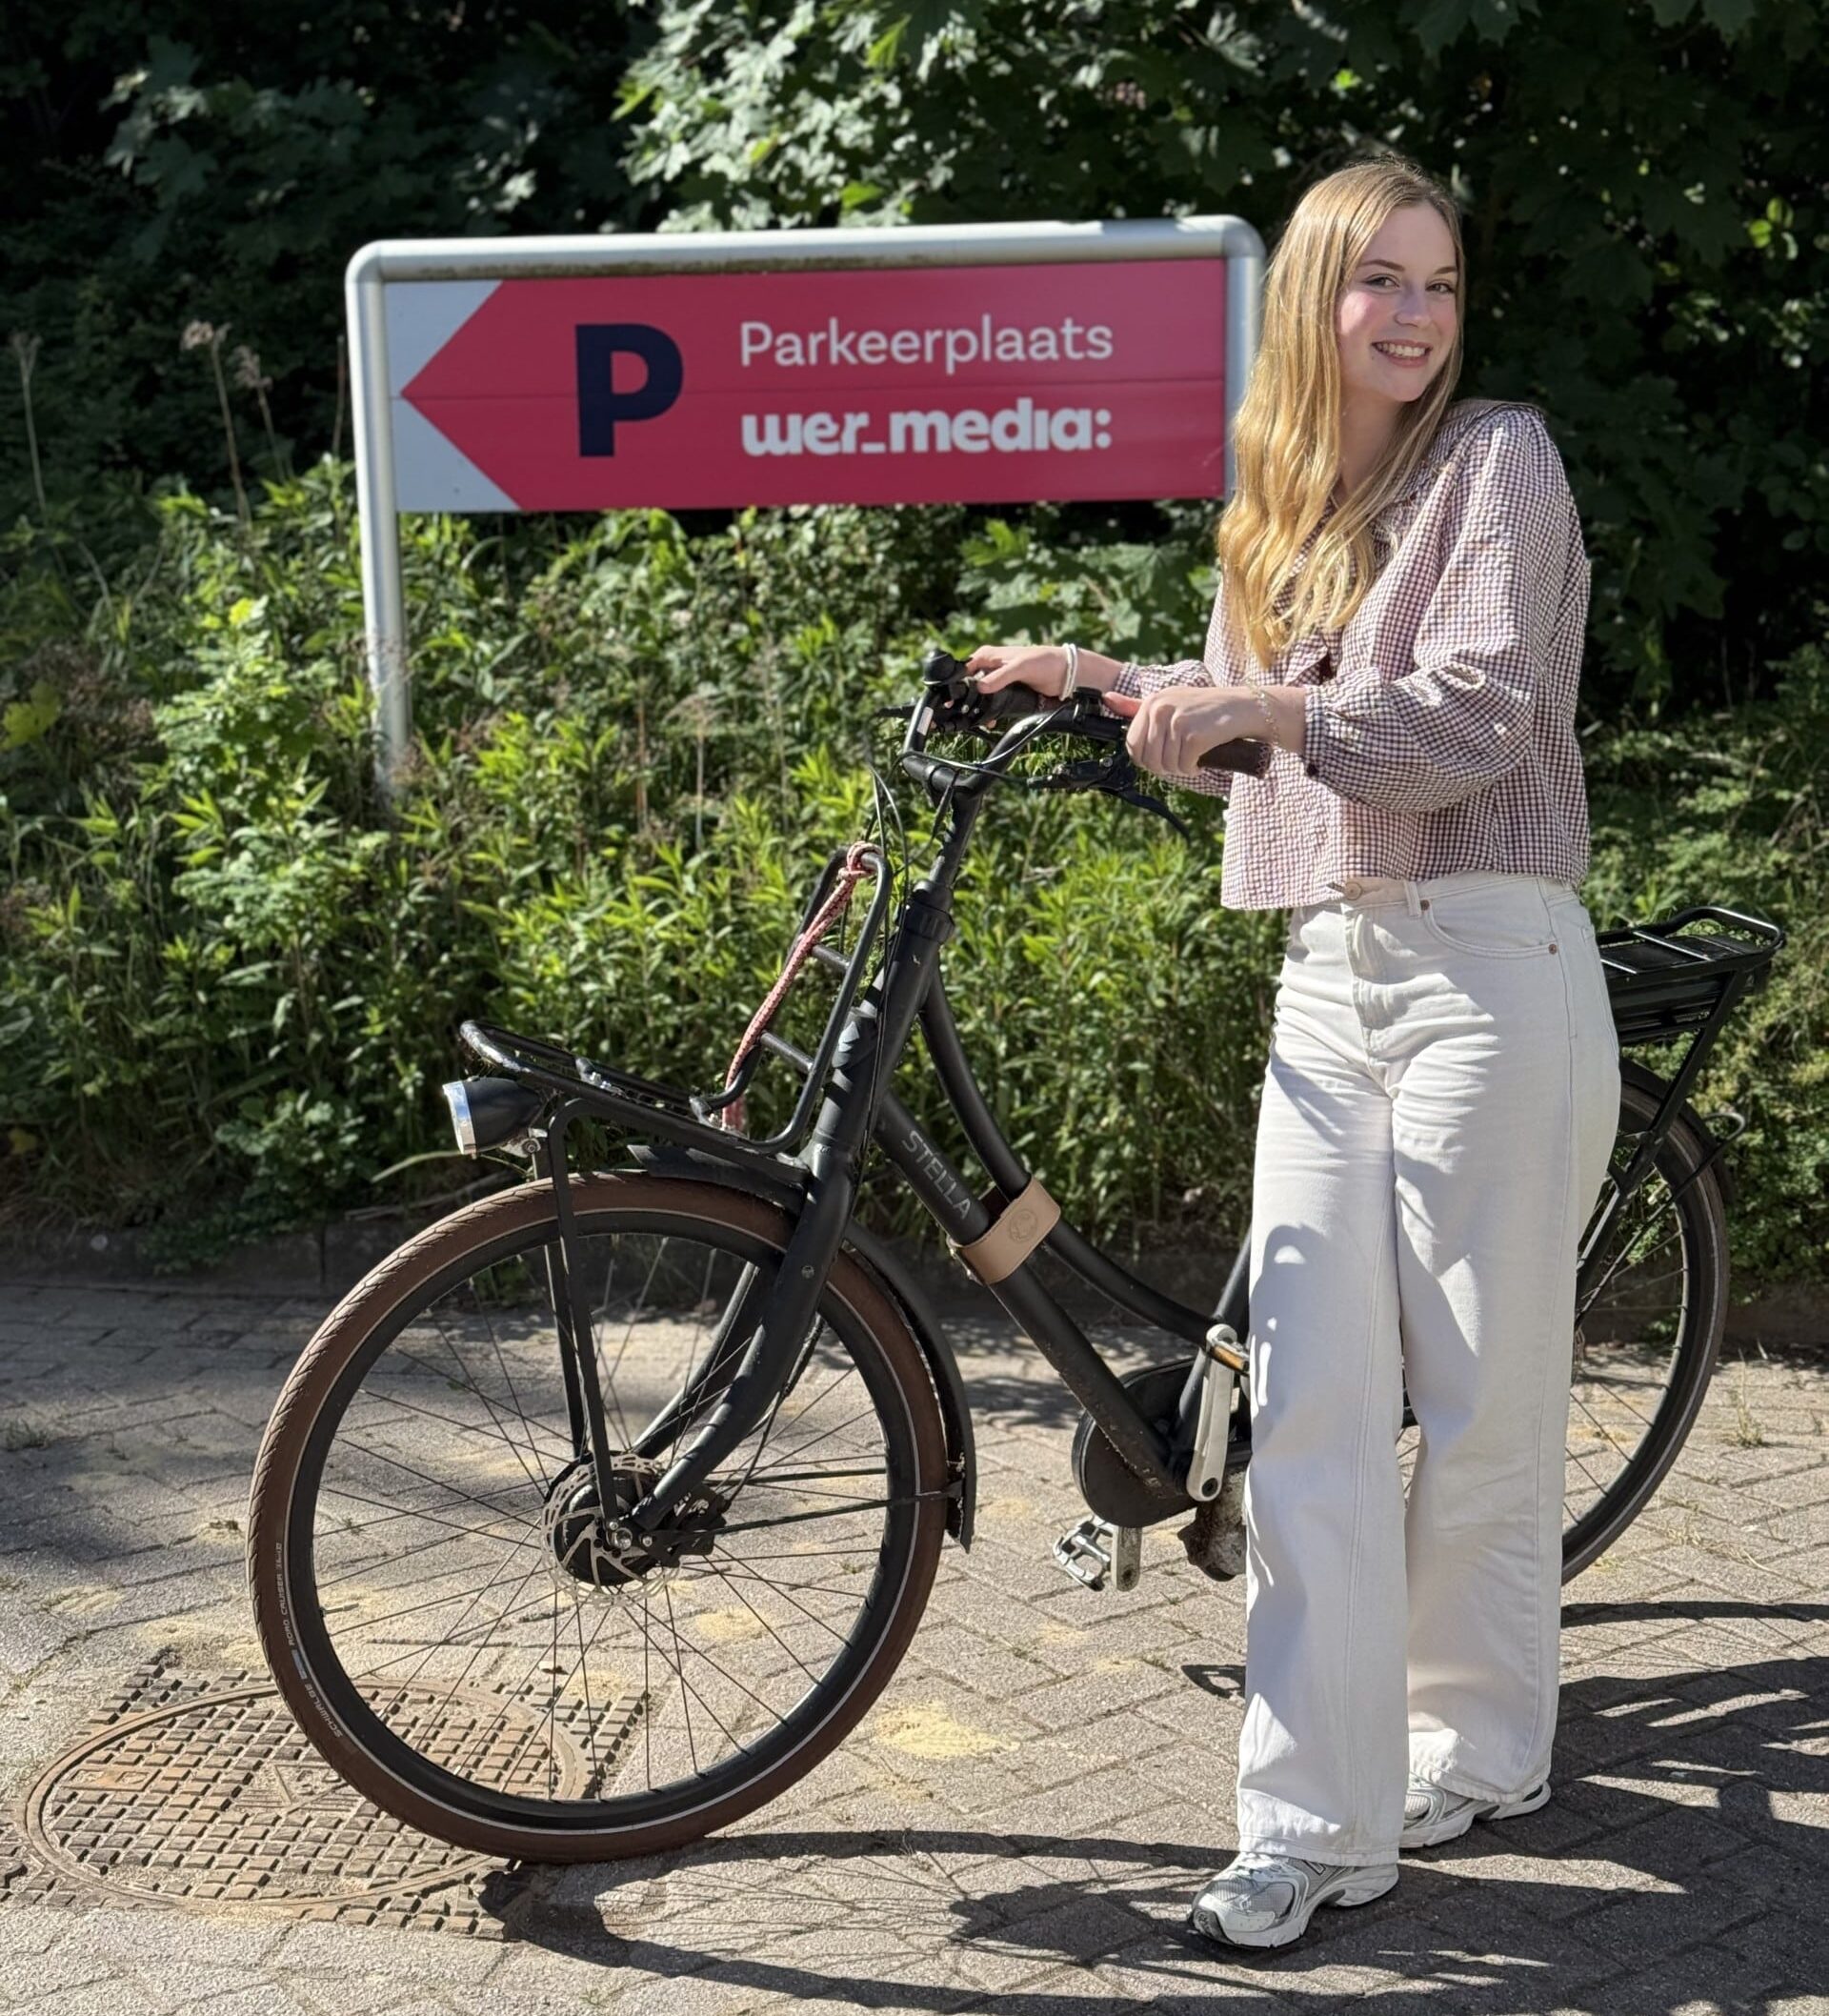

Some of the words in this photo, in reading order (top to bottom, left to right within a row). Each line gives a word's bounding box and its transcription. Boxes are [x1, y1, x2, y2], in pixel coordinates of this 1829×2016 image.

[740, 313, 1114, 375] Parkeerplaats
[575, 323, 684, 457] P
[902, 1129, 972, 1220] STELLA
